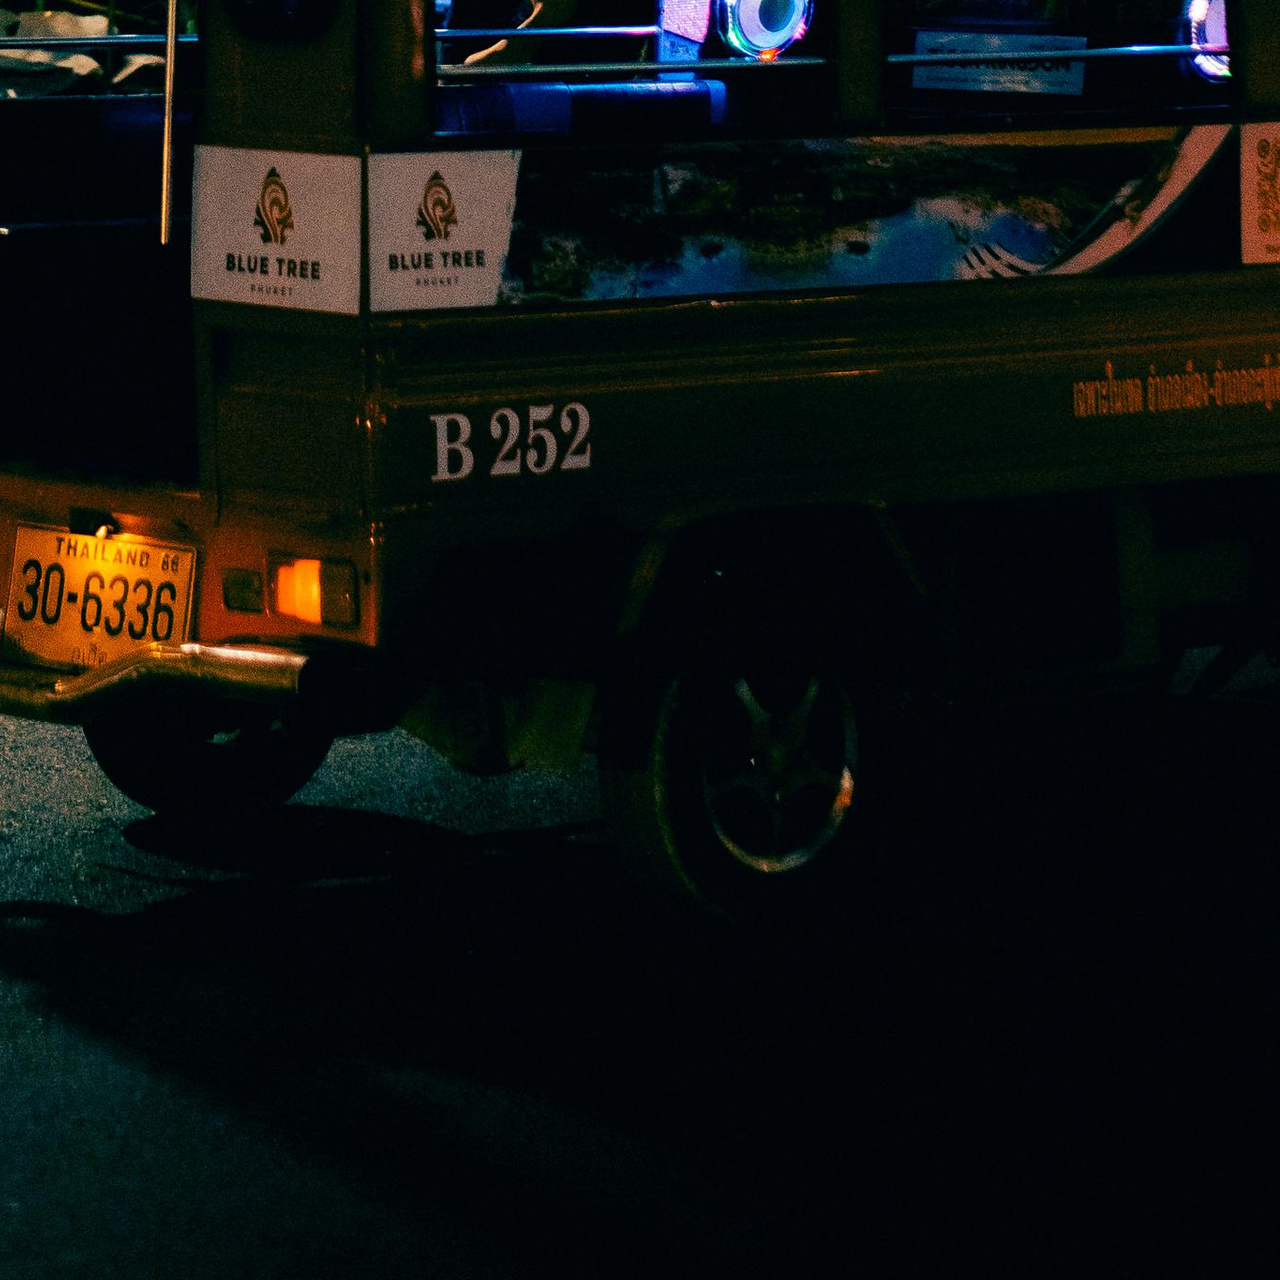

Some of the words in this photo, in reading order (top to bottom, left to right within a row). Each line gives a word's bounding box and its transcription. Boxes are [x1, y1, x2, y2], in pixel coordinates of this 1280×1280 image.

[225, 253, 269, 275] BLUE
[275, 257, 321, 280] TREE
[388, 252, 434, 271] BLUE
[440, 249, 486, 268] TREE
[428, 411, 475, 483] B
[488, 400, 592, 477] 252
[55, 536, 152, 569] THAILAND
[17, 558, 177, 642] 30-6336
